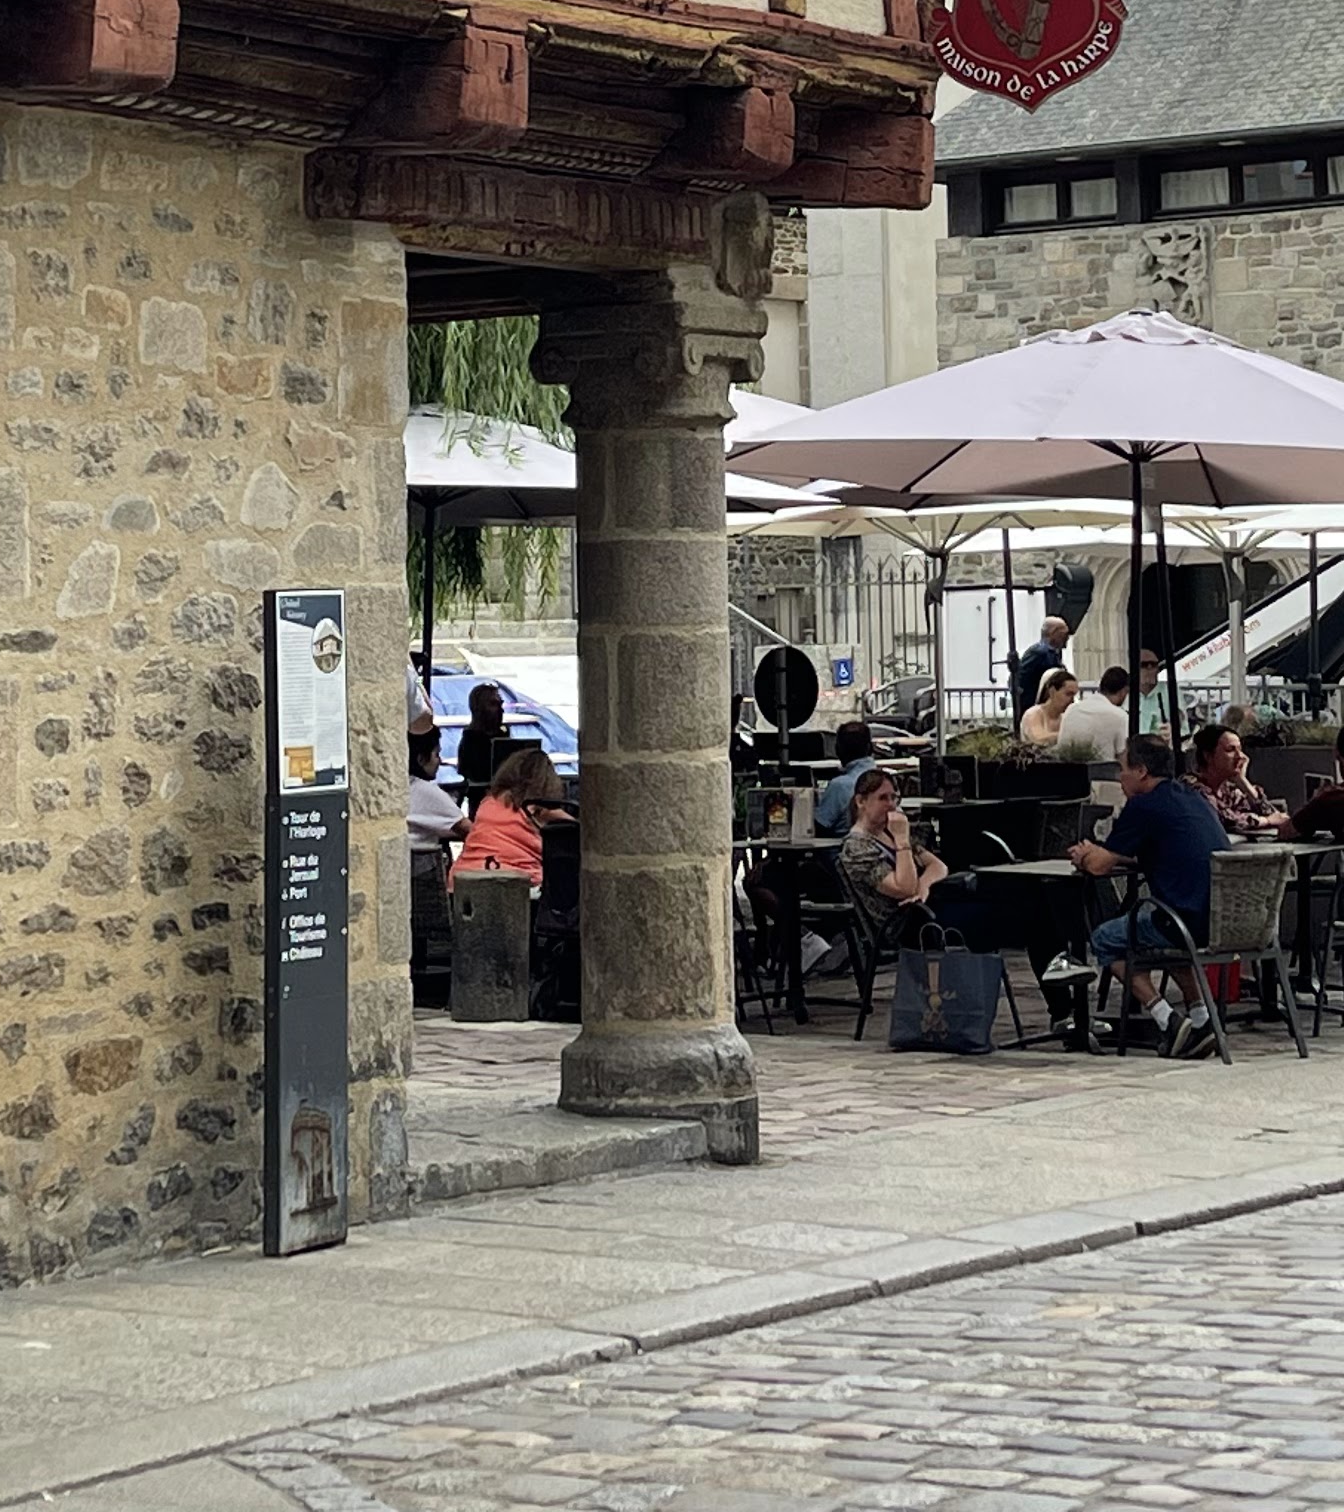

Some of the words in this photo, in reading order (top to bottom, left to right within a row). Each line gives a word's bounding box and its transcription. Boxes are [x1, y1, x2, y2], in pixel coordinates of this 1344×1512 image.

[936, 37, 1002, 88] maison
[1006, 73, 1036, 101] de
[1035, 69, 1061, 90] la
[1060, 20, 1114, 77] harpe
